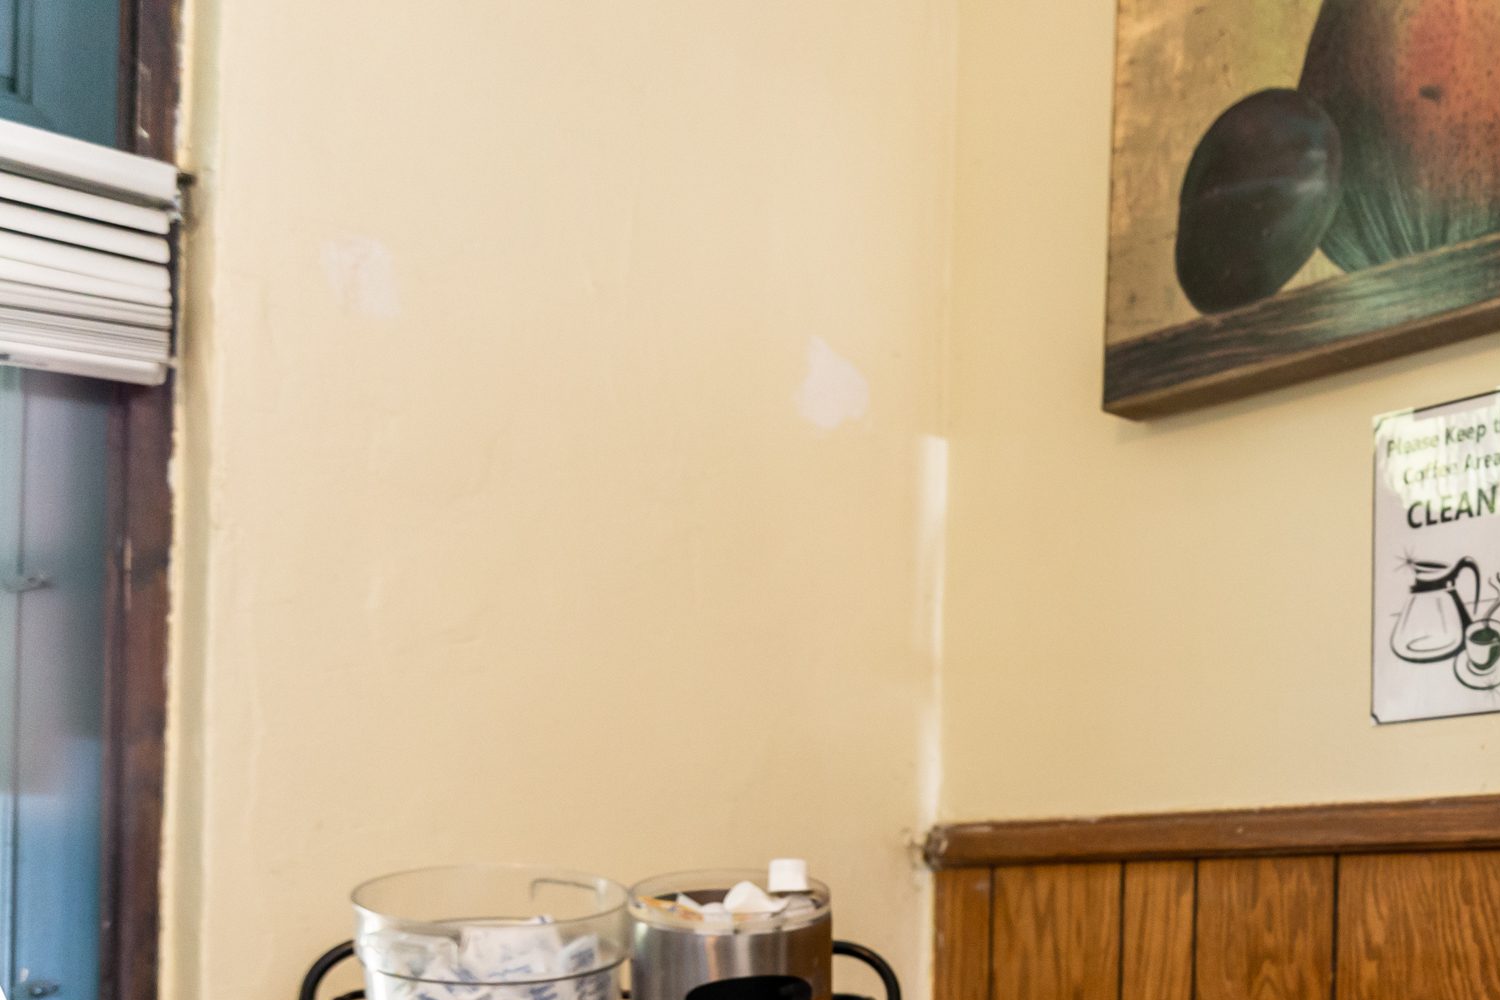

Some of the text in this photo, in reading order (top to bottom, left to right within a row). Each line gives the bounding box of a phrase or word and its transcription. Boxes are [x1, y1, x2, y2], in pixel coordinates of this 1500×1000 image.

[1387, 434, 1440, 458] Please
[1445, 423, 1487, 446] Keep
[1406, 484, 1500, 529] CLEAN
